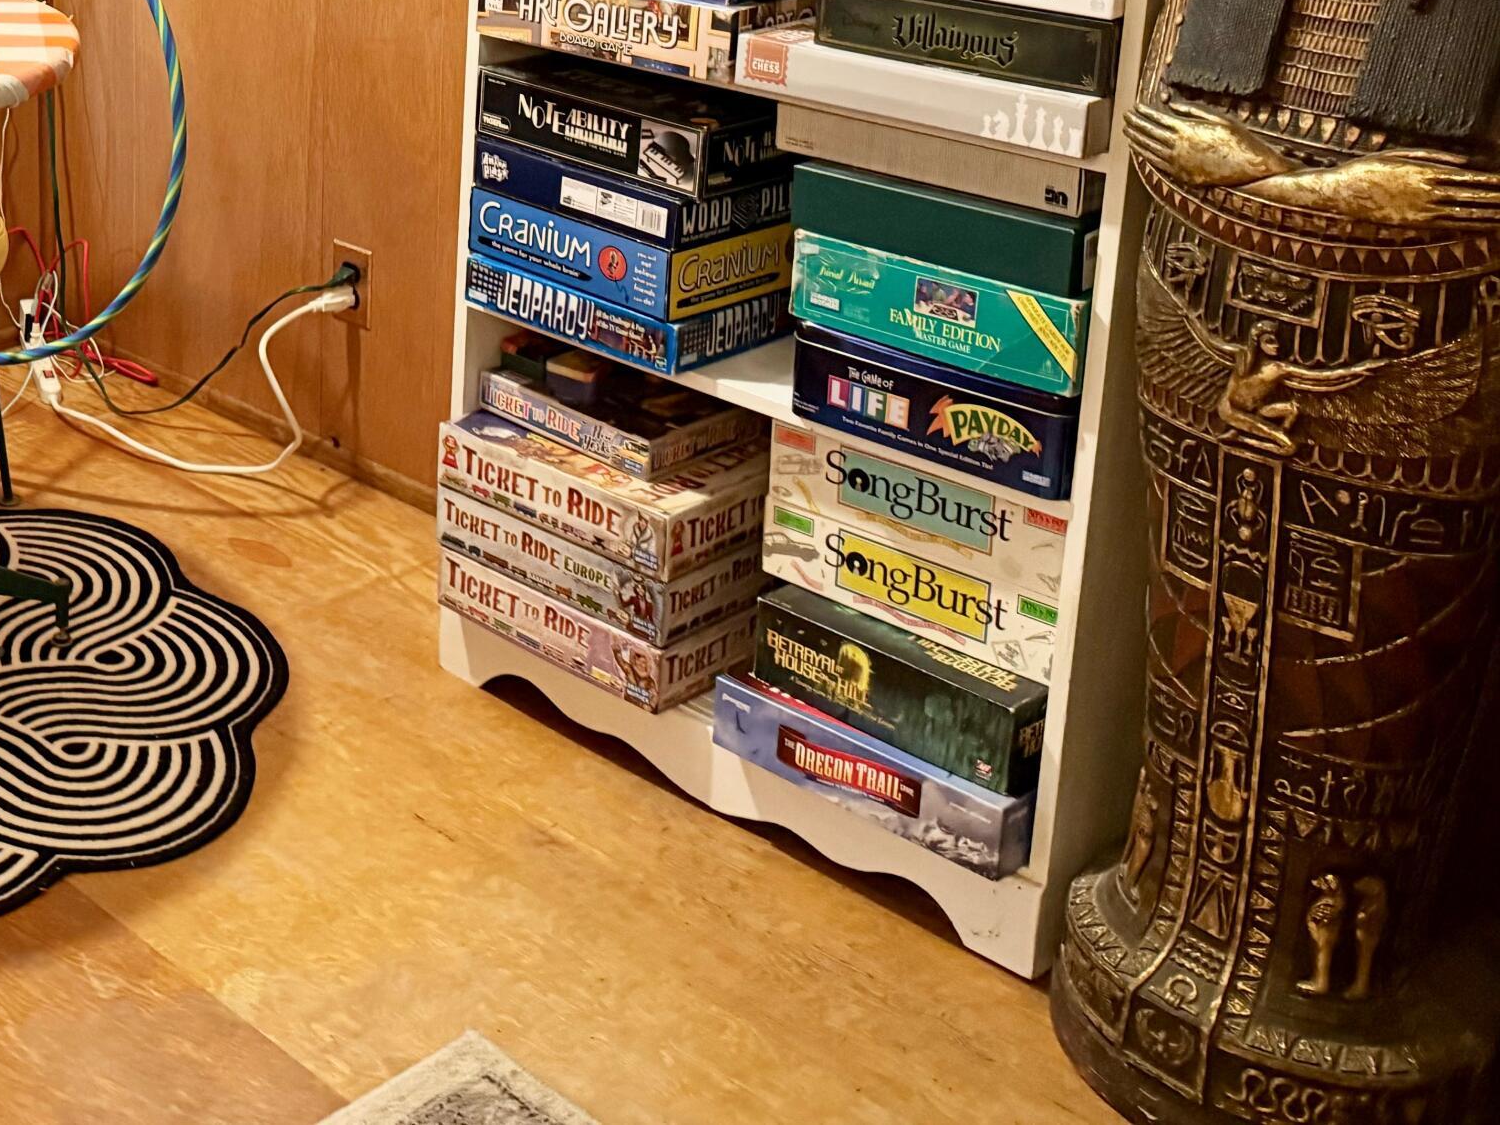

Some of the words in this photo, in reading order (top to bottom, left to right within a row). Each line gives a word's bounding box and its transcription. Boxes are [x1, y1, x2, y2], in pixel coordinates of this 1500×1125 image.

[559, 30, 596, 49] BOARD
[599, 40, 634, 56] GAME
[891, 11, 1019, 68] Villainous
[752, 60, 780, 74] CHESS
[681, 194, 733, 237] WORD
[761, 180, 792, 218] PIL
[491, 240, 501, 250] the
[502, 243, 519, 256] game
[519, 249, 528, 259] for
[528, 253, 543, 264] your
[543, 259, 562, 272] whole
[562, 264, 581, 278] brain
[496, 271, 595, 340] JEOPARDY!
[705, 291, 781, 357] JEOPARDY!
[890, 307, 938, 334] FAMILY
[941, 323, 1001, 353] EDITION
[915, 330, 947, 347] MASTER
[947, 338, 972, 354] GAME
[485, 382, 532, 419] TICKET
[532, 406, 545, 422] TO
[546, 403, 582, 442] RIDE
[830, 377, 907, 429] LIFE
[949, 408, 1035, 448] PAYDAY
[924, 442, 938, 452] One
[462, 443, 540, 503] TICKET
[541, 484, 562, 508] TO
[566, 485, 623, 537] RIDE
[825, 449, 1014, 543] SongBurst
[444, 497, 502, 543] TICKET
[503, 529, 518, 547] TO
[521, 528, 562, 572] RIDE
[563, 553, 612, 591] EUROPE
[686, 498, 749, 548] TICKET
[445, 554, 521, 620] TICKET
[522, 600, 541, 622] TO
[544, 603, 593, 651] RIDE
[669, 574, 717, 615] TICKET
[824, 532, 1009, 632] SongBurst
[665, 632, 730, 685] TICKET
[767, 628, 837, 674] BETRAYAL
[774, 647, 822, 684] HOUSE
[836, 675, 869, 704] HILL
[784, 737, 796, 750] THE
[794, 741, 855, 782] OREGON
[856, 762, 902, 803] TRAIL
